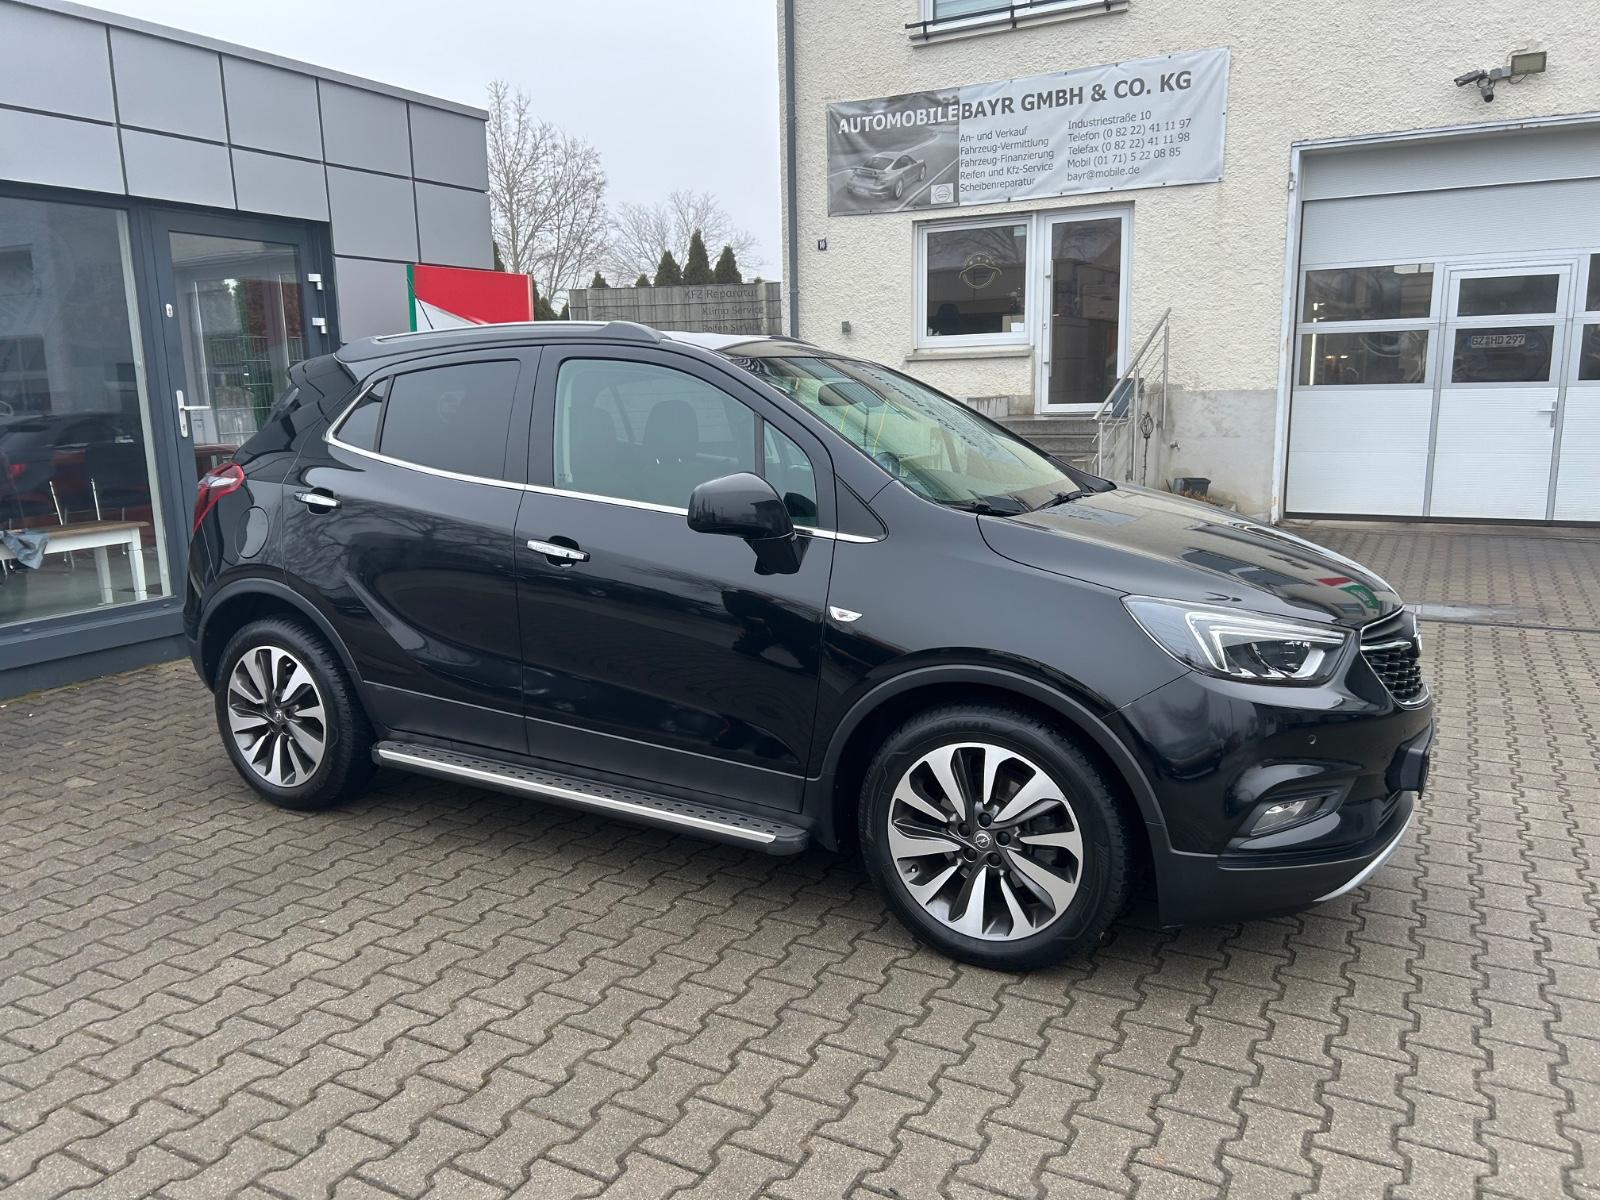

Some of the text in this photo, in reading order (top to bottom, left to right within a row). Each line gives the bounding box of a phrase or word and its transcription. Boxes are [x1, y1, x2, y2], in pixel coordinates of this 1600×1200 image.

[838, 71, 1192, 134] AUTOMOBILE BAYR GMBH & CO. KG
[1068, 110, 1151, 130] Industriestraße 10
[960, 126, 1028, 143] An- und Verkauf
[1068, 118, 1192, 143] Telefon (0 82 22) 41 11 97
[960, 138, 1049, 155] Fahrzeug-Vermittlung
[1068, 132, 1190, 156] Telefax (0 82 22) 41 11 98
[960, 150, 1054, 167] Fahrzeug-Finanzierung
[1067, 146, 1181, 169] Mobil (01 71) 5 22 08 85
[960, 161, 1053, 180] Reifen und Kfz-Service
[1067, 165, 1140, 182] bayr@mobile.de
[960, 177, 1036, 193] Scheibenreparatur
[1505, 334, 1525, 345] 297
